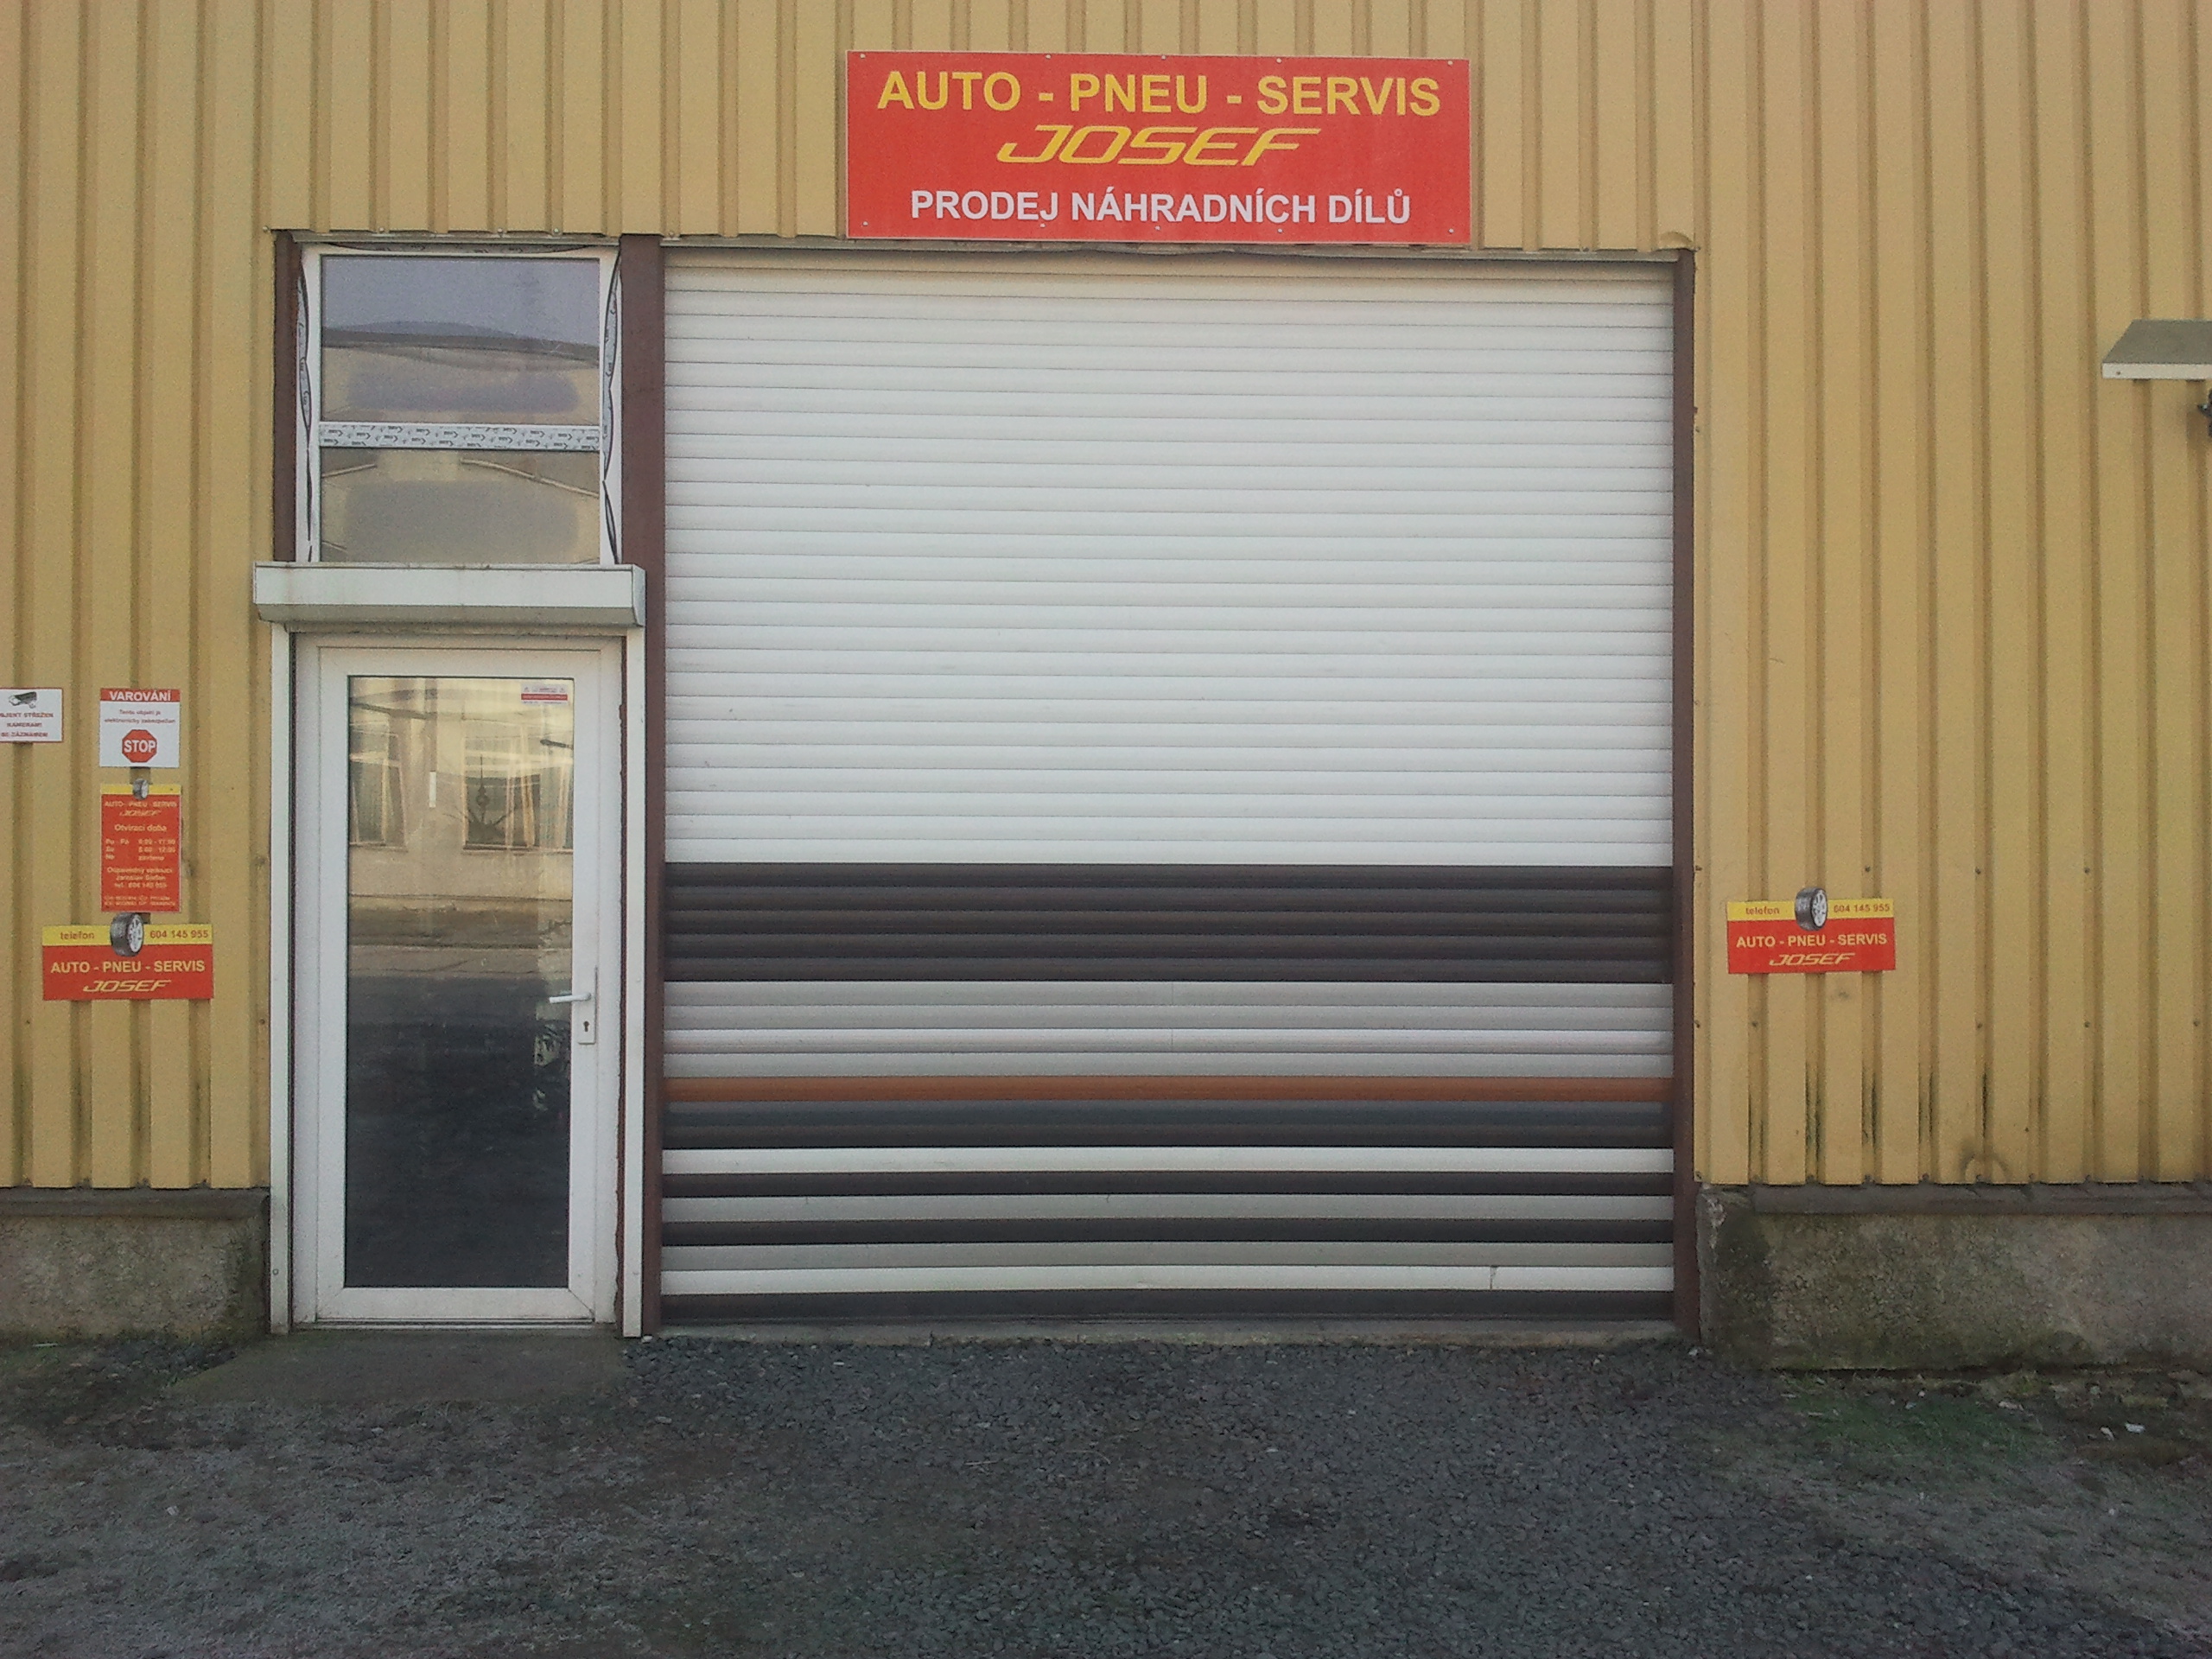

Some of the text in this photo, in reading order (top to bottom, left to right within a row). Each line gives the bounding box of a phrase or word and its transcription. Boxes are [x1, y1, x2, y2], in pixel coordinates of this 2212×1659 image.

[877, 70, 1020, 111] AUTO
[1071, 73, 1207, 114] PNEU
[1257, 75, 1441, 117] SERVIS
[996, 124, 1322, 166] JOSEF
[912, 186, 1410, 224] PRODEJ NÁHRADNÍCH DÍLŮ
[109, 689, 171, 702] VAROVÁNÍ
[124, 739, 156, 753] STOP
[1745, 903, 1891, 915] telefon 604 145 955
[60, 930, 209, 940] telefon 604 145 955
[1736, 935, 1776, 948] AUTO
[1788, 934, 1826, 947] PNEU
[1838, 933, 1888, 945] SERVIS
[1769, 952, 1856, 966] JOSEF
[50, 962, 91, 974] AUTO
[103, 961, 142, 973] PNEU
[154, 960, 206, 973] SERVIS
[82, 980, 172, 992] JOSEF
